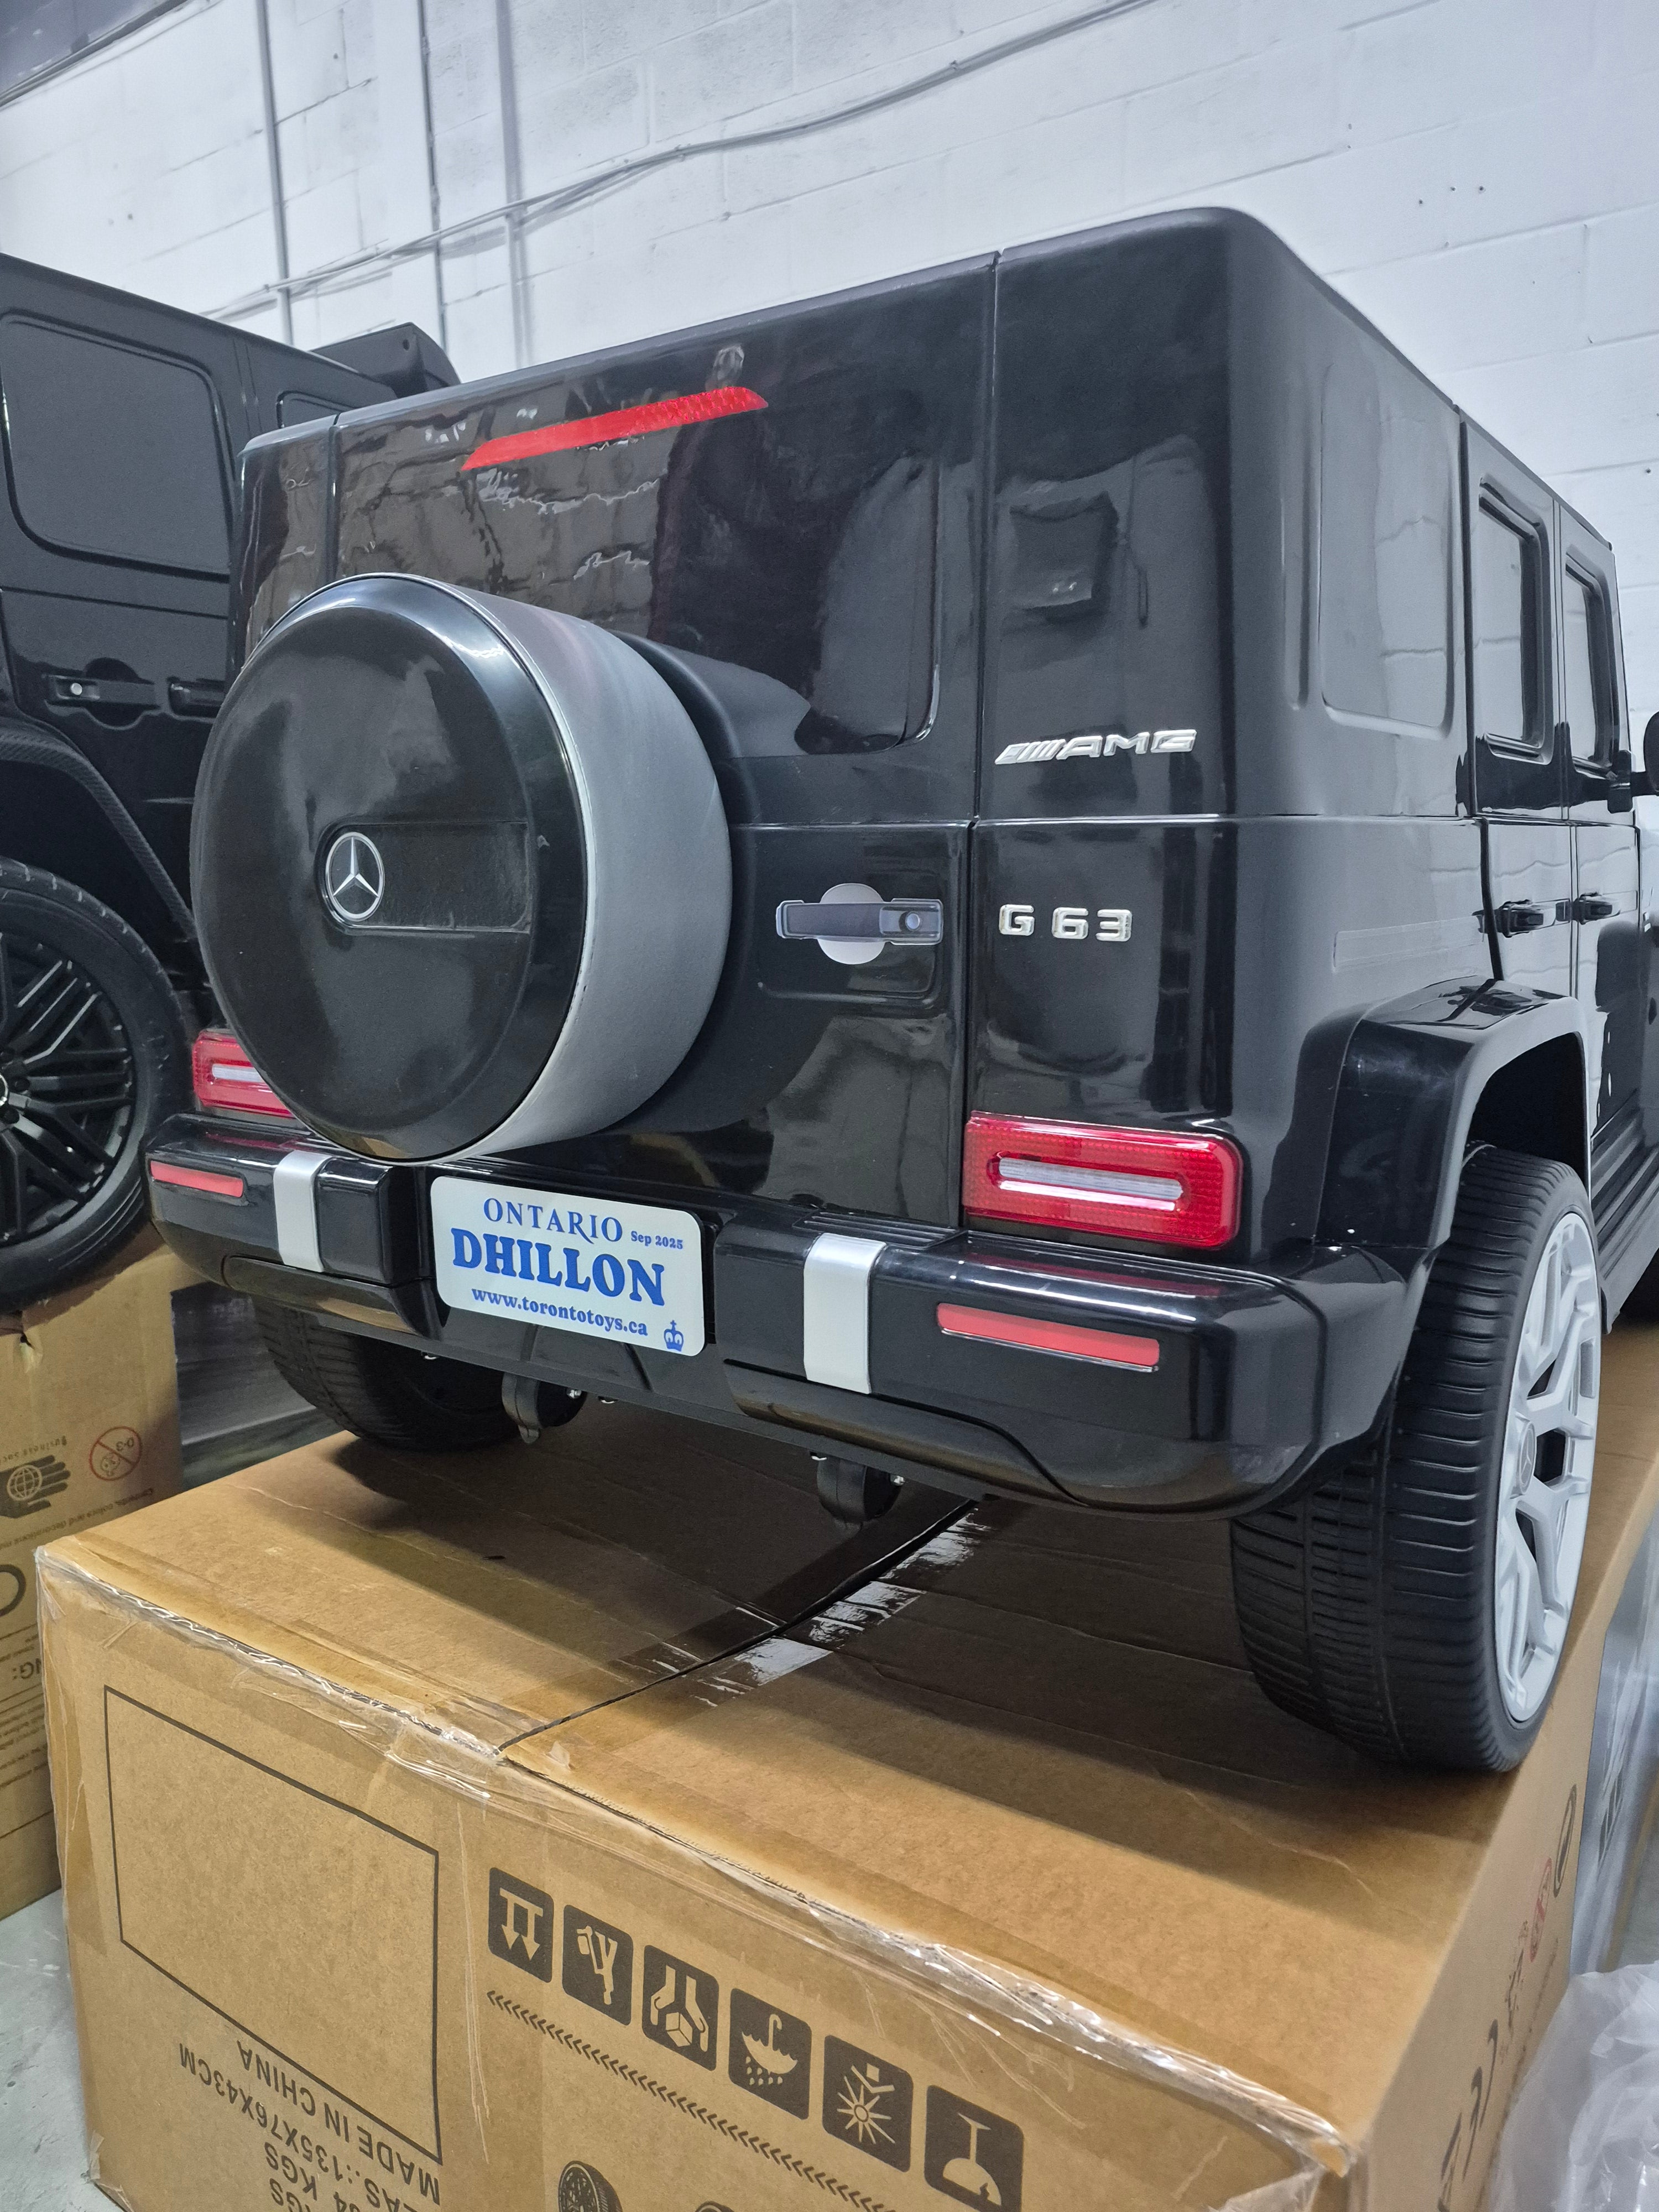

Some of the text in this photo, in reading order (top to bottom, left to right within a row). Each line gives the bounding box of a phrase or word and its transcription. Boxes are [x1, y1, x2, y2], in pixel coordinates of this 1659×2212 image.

[1055, 729, 1197, 760] AMG
[998, 904, 1133, 942] G 63
[483, 1197, 623, 1244] ONTARIO
[630, 1230, 684, 1250] Sep 2025
[450, 1227, 665, 1306] DHILLON
[471, 1288, 649, 1337] www.torontotoys.ca
[237, 2039, 441, 2206] MADE IN CHINA
[264, 2141, 317, 2201] KGS
[269, 2177, 312, 2212] GS
